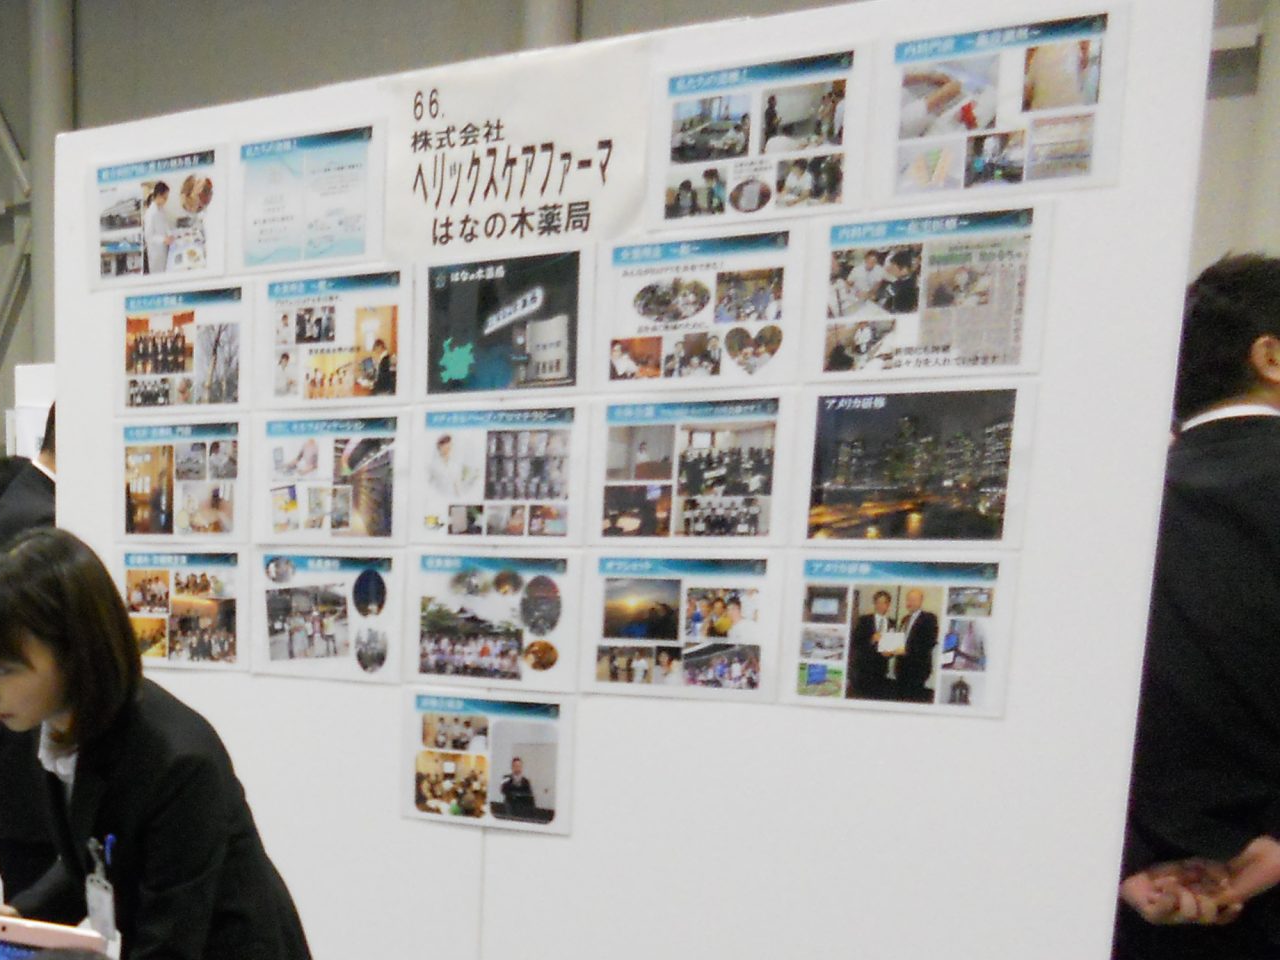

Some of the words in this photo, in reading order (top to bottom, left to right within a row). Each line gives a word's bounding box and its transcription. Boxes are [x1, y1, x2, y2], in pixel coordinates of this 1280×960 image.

[411, 119, 505, 153] 株式会社
[412, 138, 613, 209] ヘリックスケアファーマ
[431, 200, 591, 246] はなの木薬局
